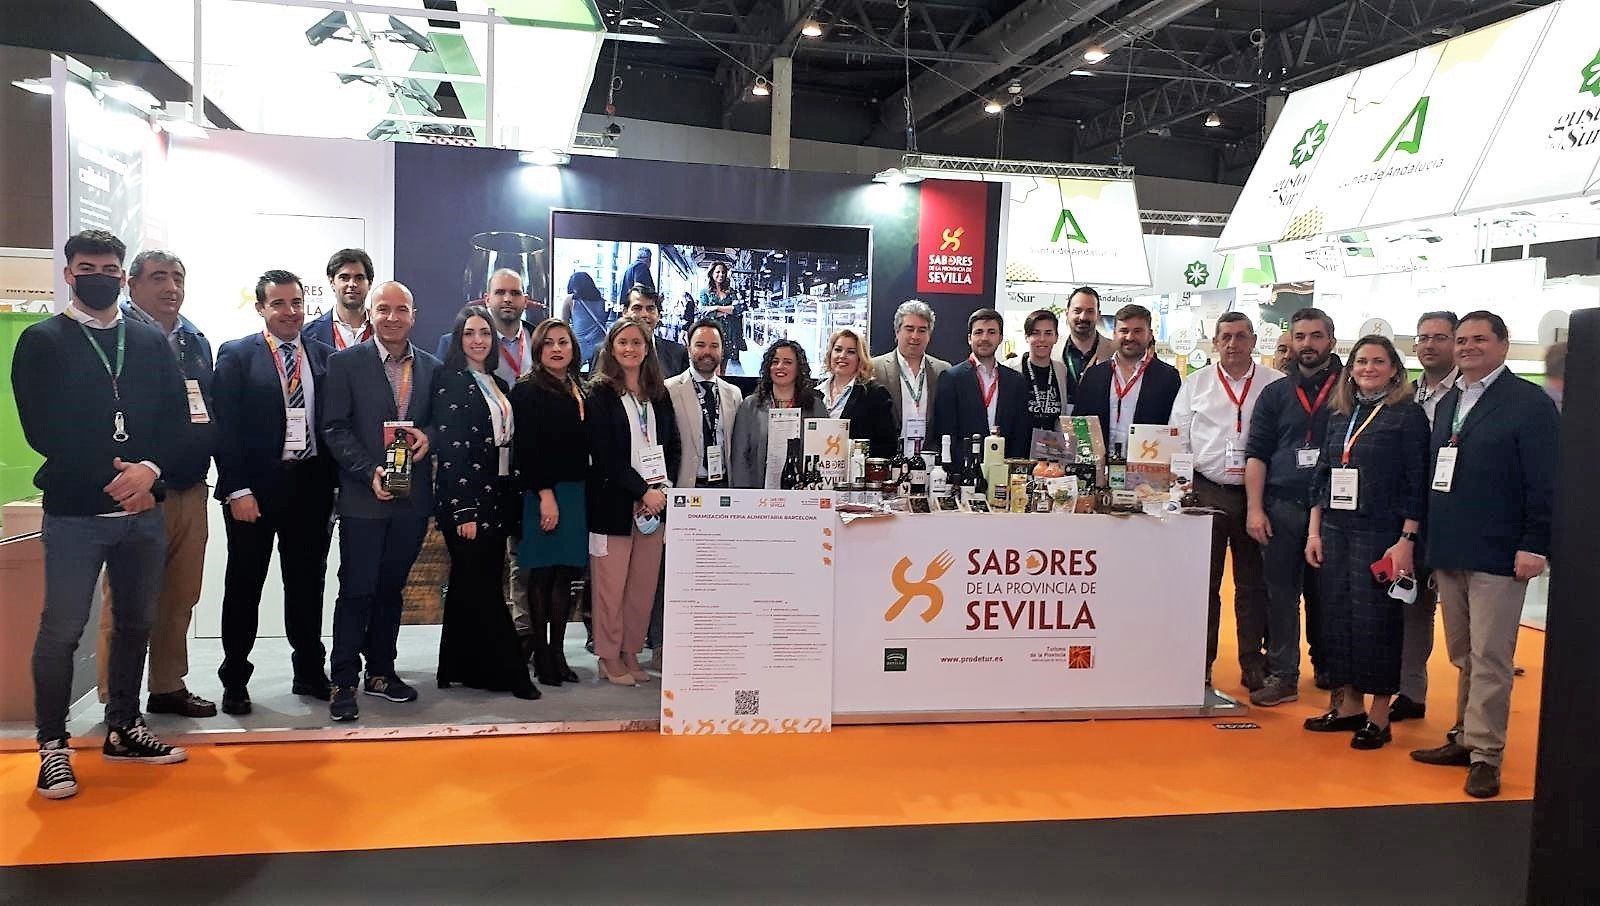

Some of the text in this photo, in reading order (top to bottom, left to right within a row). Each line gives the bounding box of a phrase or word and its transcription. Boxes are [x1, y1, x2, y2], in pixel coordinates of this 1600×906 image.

[928, 254, 973, 267] SABORES
[927, 271, 973, 285] SEVILLA
[968, 549, 1097, 576] SABORES
[966, 582, 1097, 594] DE LA PROVINCIA DE
[966, 600, 1096, 631] SEVILLA
[940, 655, 1004, 664] www.prodetur.es
